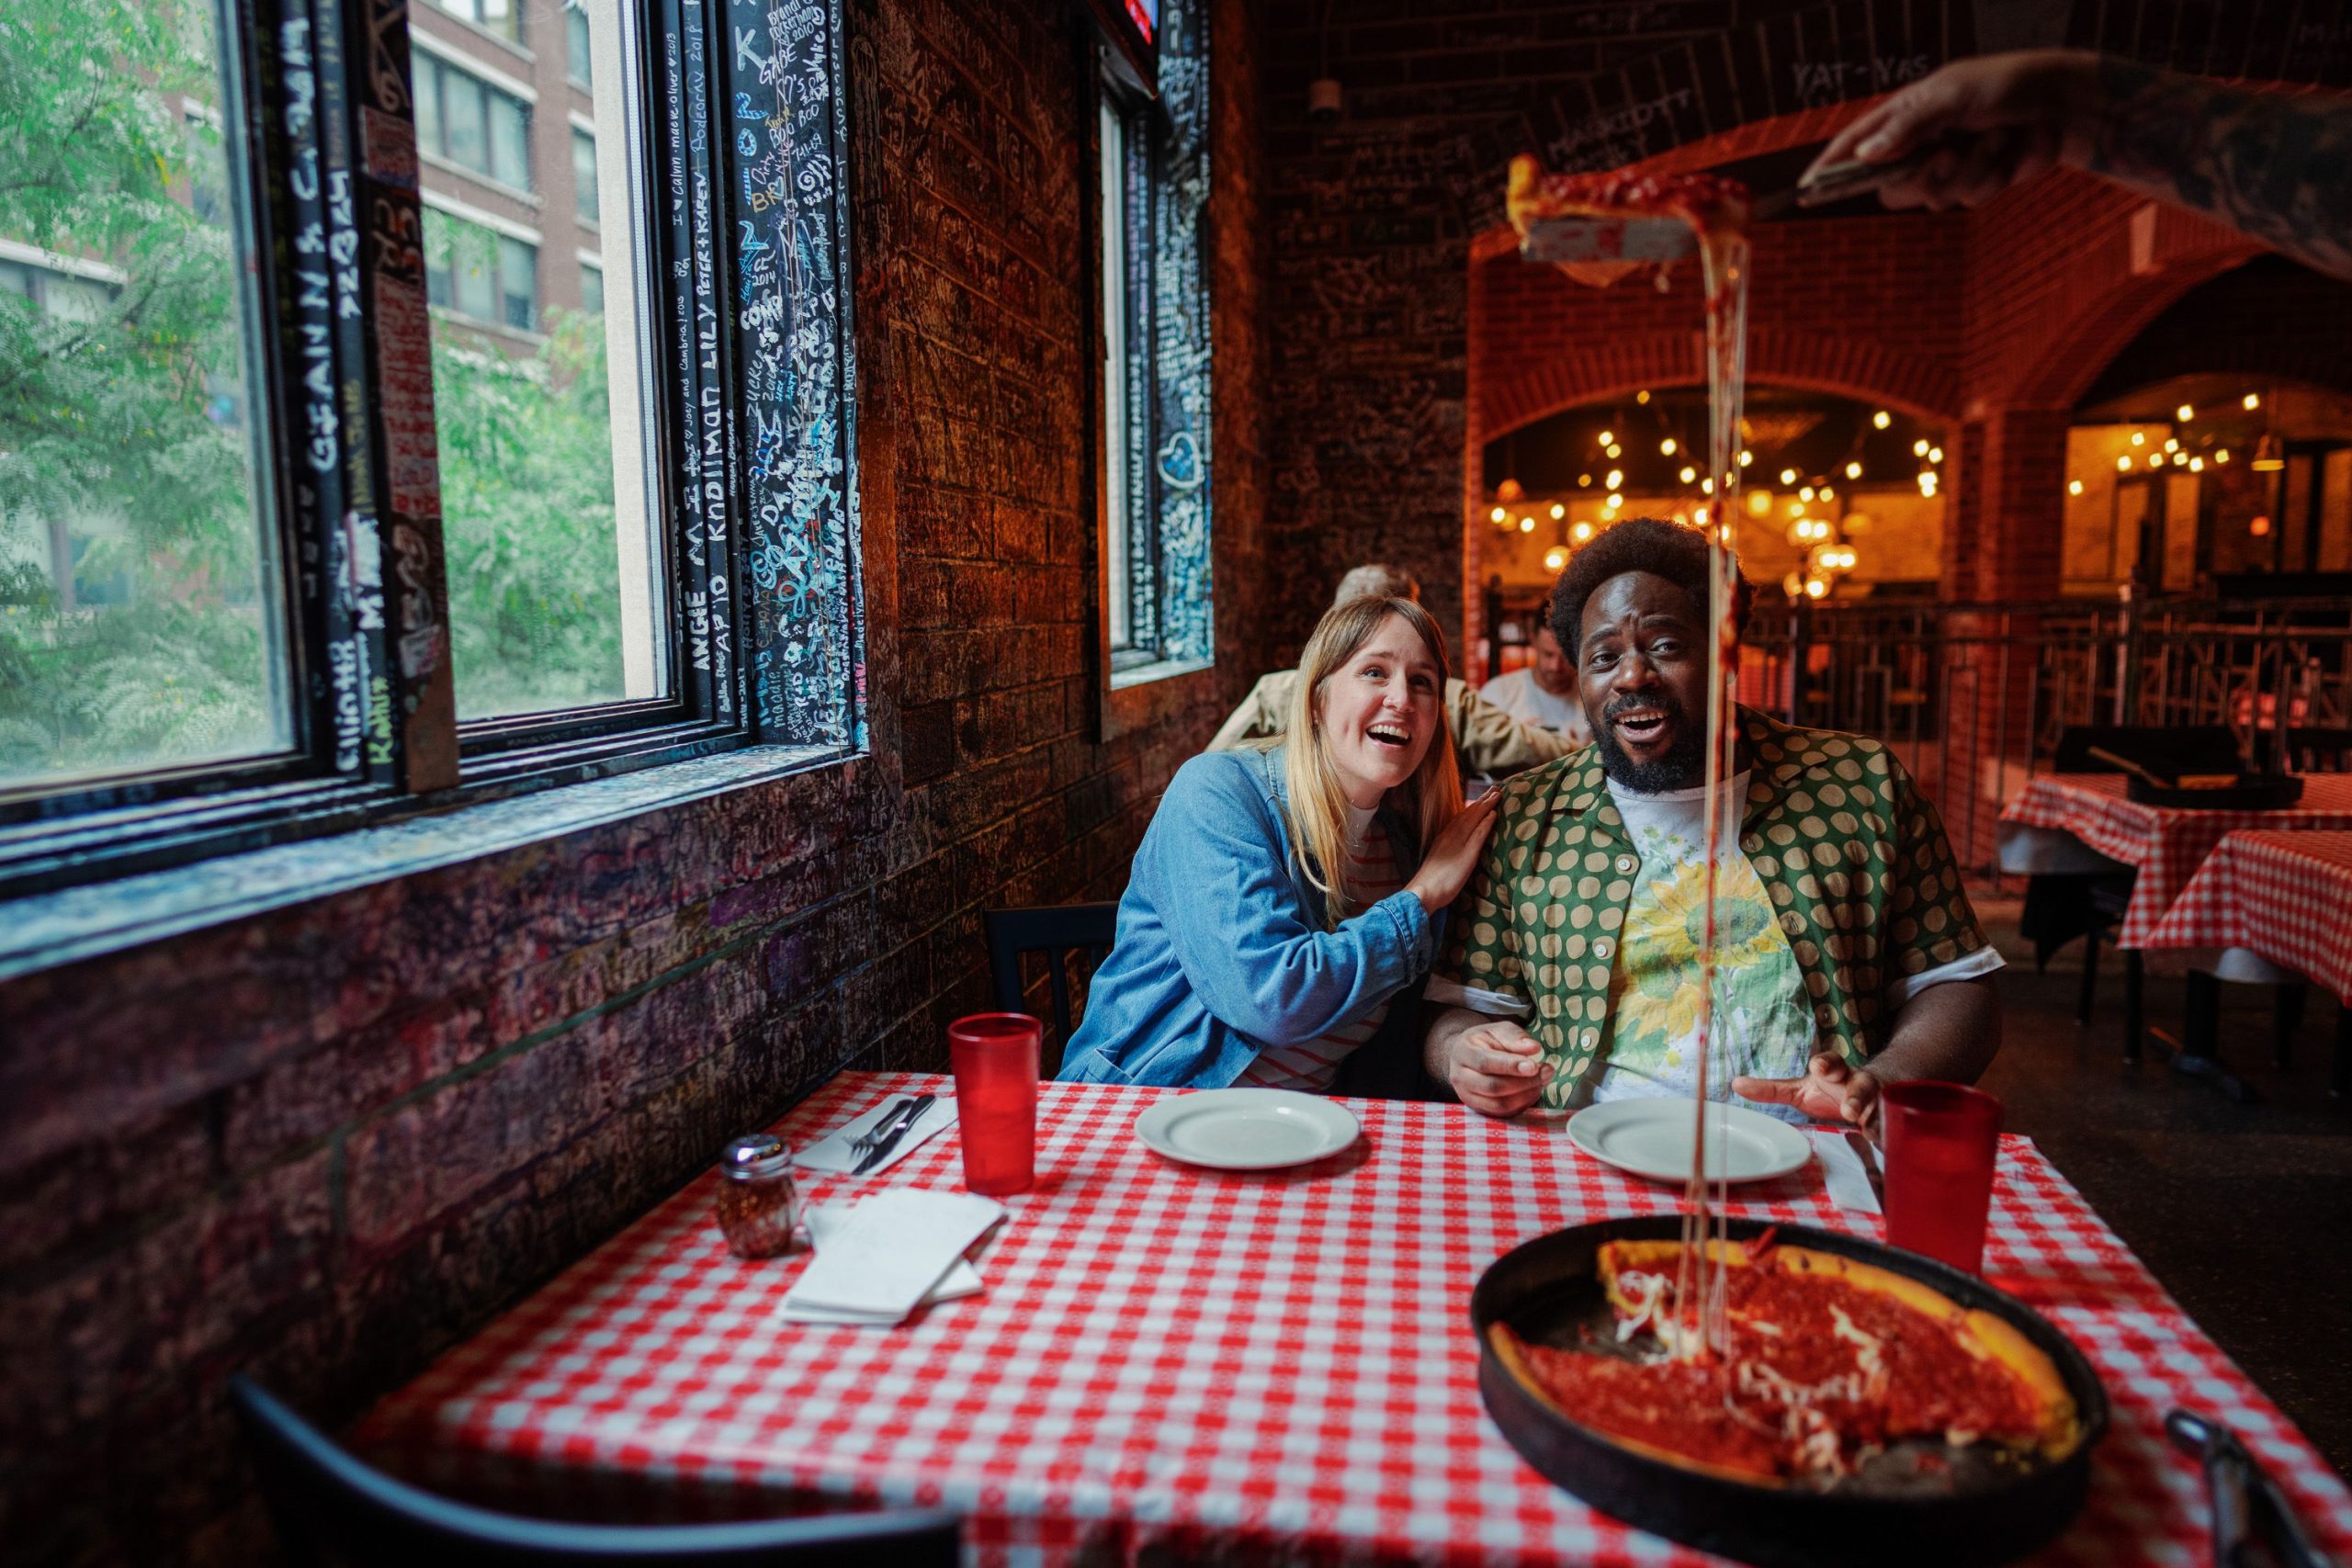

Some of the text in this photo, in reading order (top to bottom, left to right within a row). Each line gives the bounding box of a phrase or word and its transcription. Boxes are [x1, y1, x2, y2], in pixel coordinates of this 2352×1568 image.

[666, 32, 677, 55] 2013
[759, 43, 798, 85] GABE
[671, 156, 684, 195] Calvin
[692, 171, 708, 232] KAREN
[695, 250, 711, 297] PETER
[696, 302, 717, 370] LILY
[681, 378, 690, 398] and
[684, 401, 696, 426] Joey
